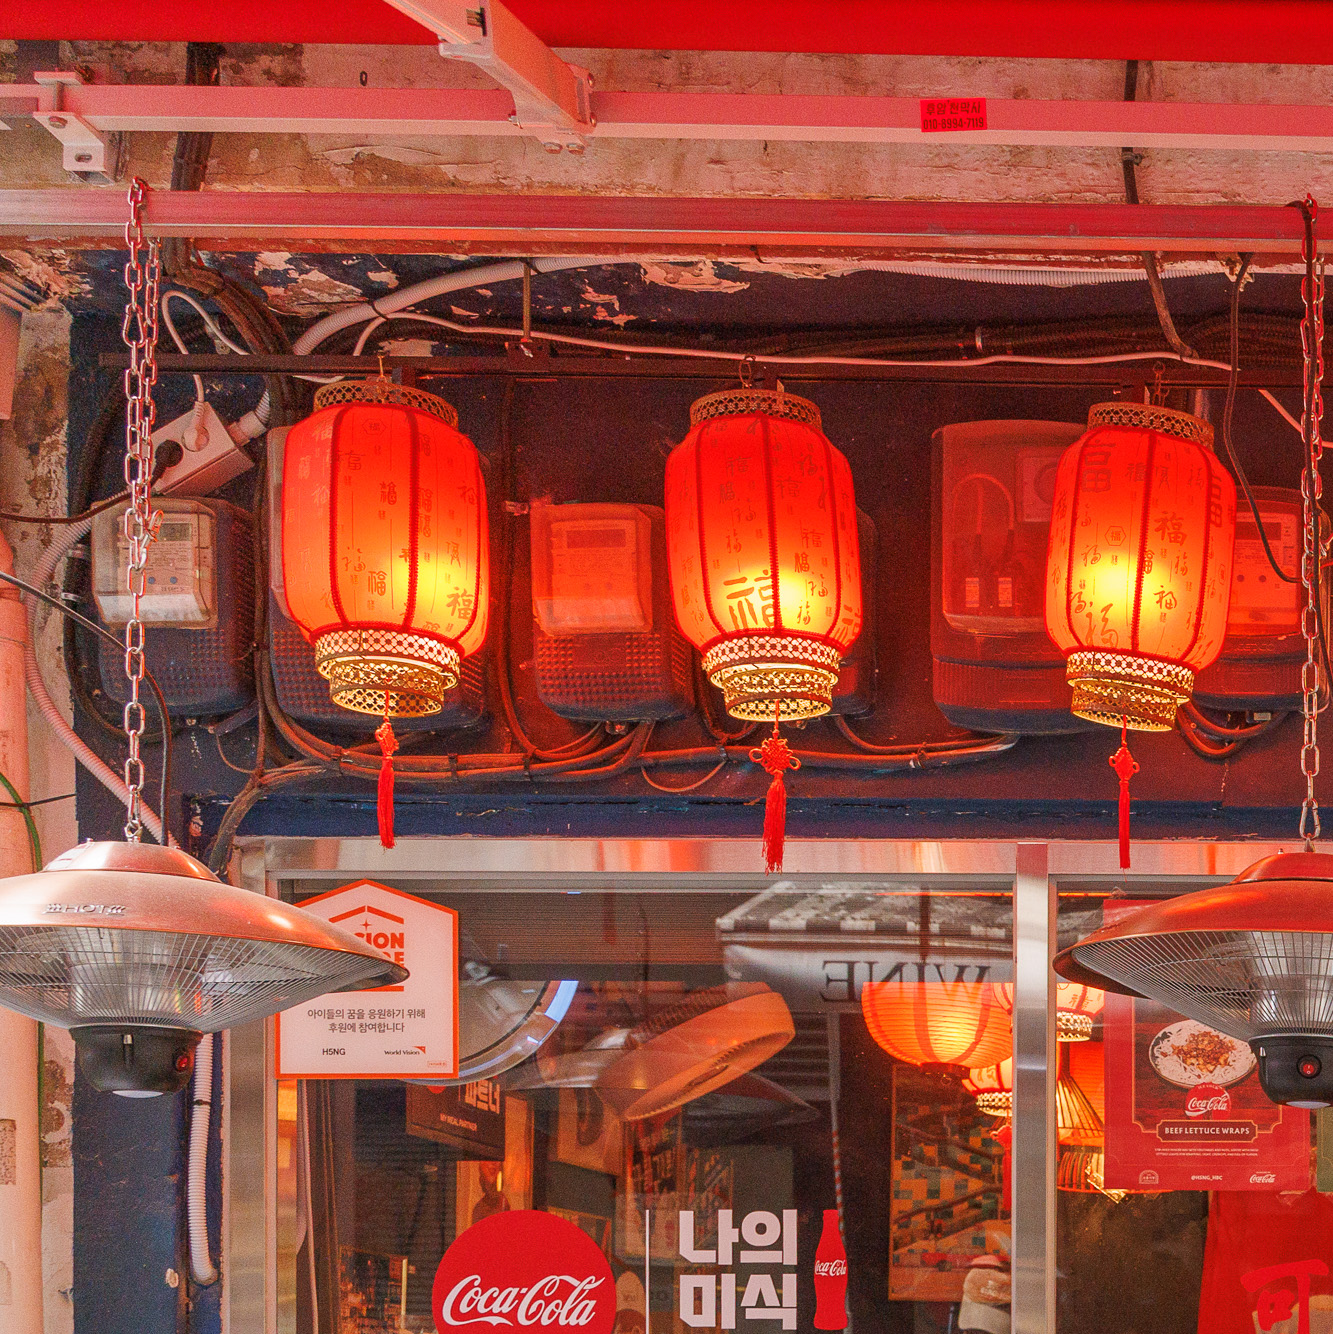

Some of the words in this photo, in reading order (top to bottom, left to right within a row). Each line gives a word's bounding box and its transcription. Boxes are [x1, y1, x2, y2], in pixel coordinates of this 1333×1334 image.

[950, 102, 980, 115] 천막사
[923, 117, 984, 130] 010-8994-7119
[307, 1009, 345, 1019] 아이들의
[347, 1009, 365, 1019] 꿈을
[368, 1009, 404, 1019] 응원하기
[407, 1008, 426, 1019] 위해
[328, 1022, 356, 1033] 후원에
[358, 1022, 405, 1033] 참여합니다
[322, 1048, 346, 1056] H5NG
[1165, 1127, 1182, 1135] BEEF
[1185, 1127, 1220, 1135] LETTUCE
[1222, 1127, 1250, 1135] WRAPS
[679, 1209, 798, 1265] 나의
[814, 1258, 847, 1277] Coca-Cola
[442, 1274, 606, 1327] Coca-Cola
[679, 1273, 798, 1330] 미식
